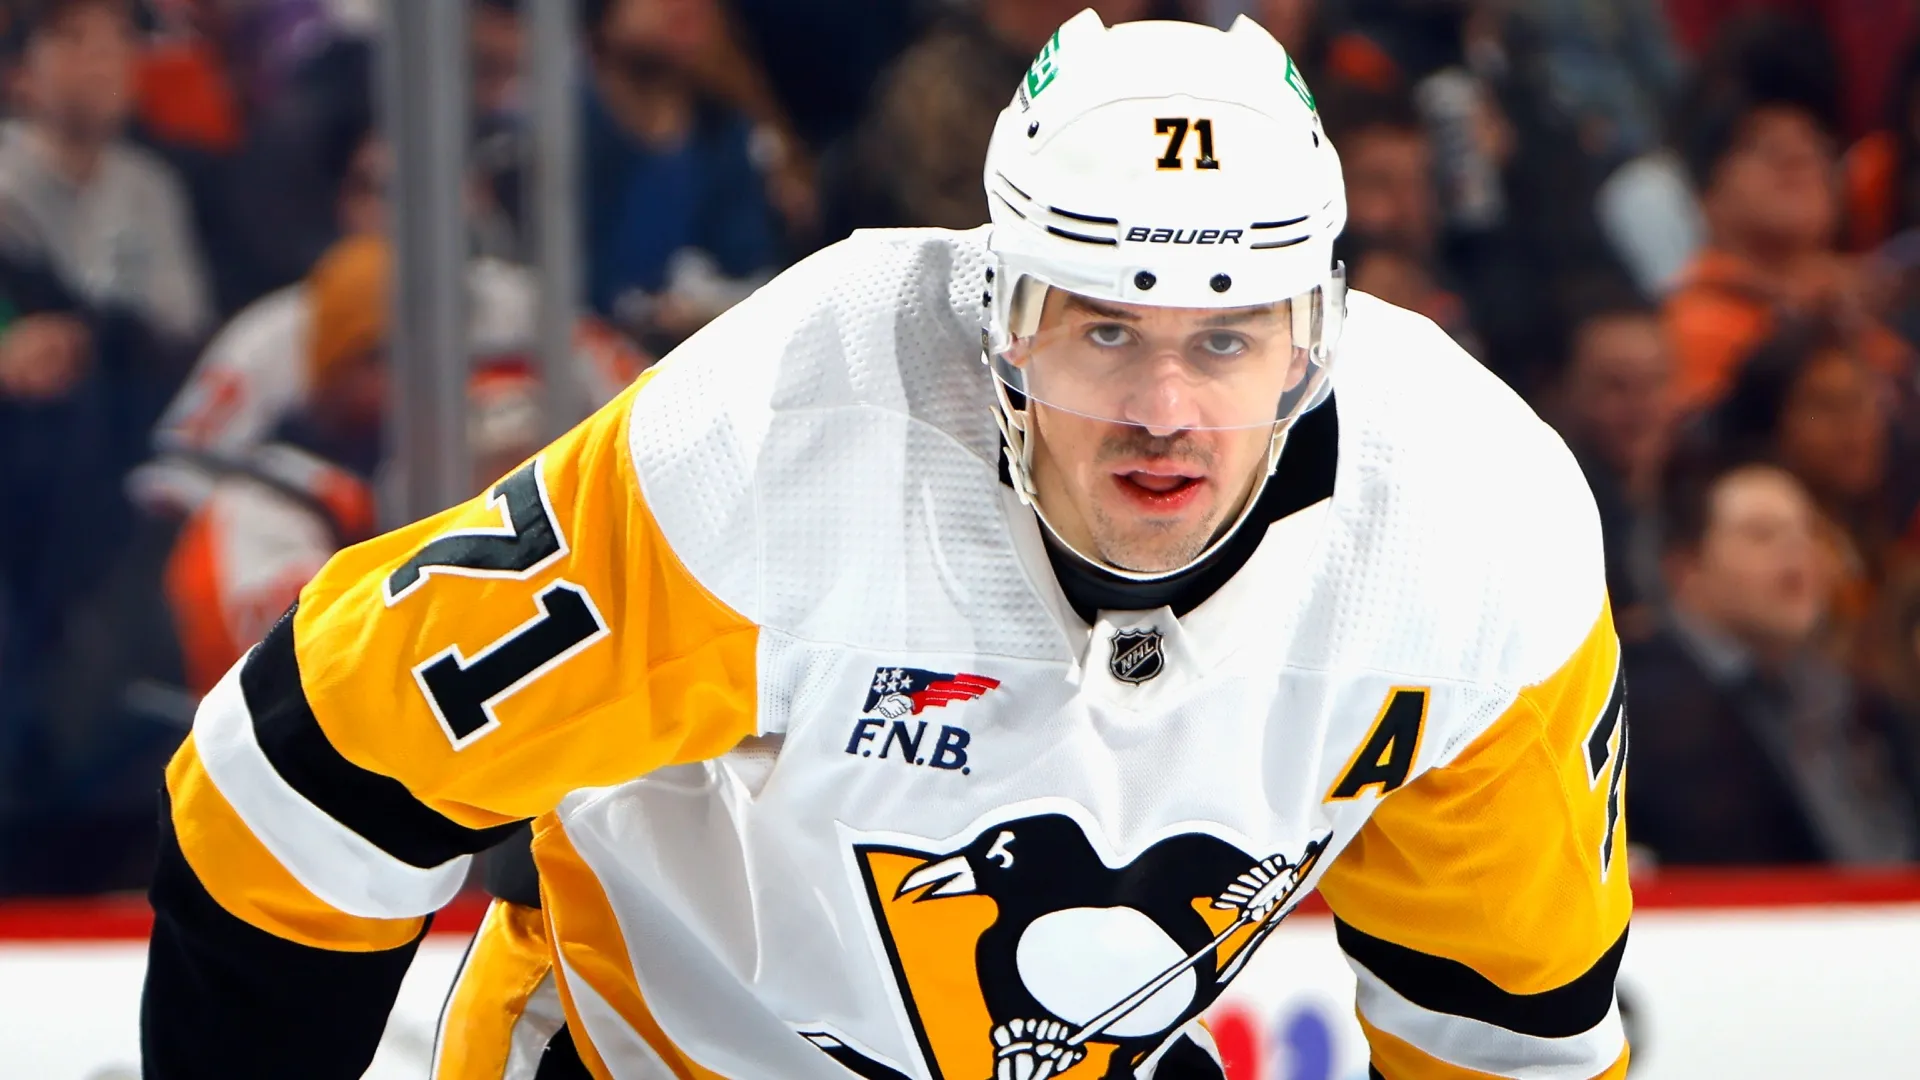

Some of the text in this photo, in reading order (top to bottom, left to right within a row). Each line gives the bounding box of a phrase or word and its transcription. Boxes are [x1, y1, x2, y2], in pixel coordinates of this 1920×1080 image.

[1155, 117, 1221, 171] 71
[1125, 226, 1244, 245] BAUER
[382, 452, 612, 752] 71
[1120, 640, 1155, 674] NHL
[845, 718, 972, 776] F.N.B.
[1321, 684, 1432, 804] A
